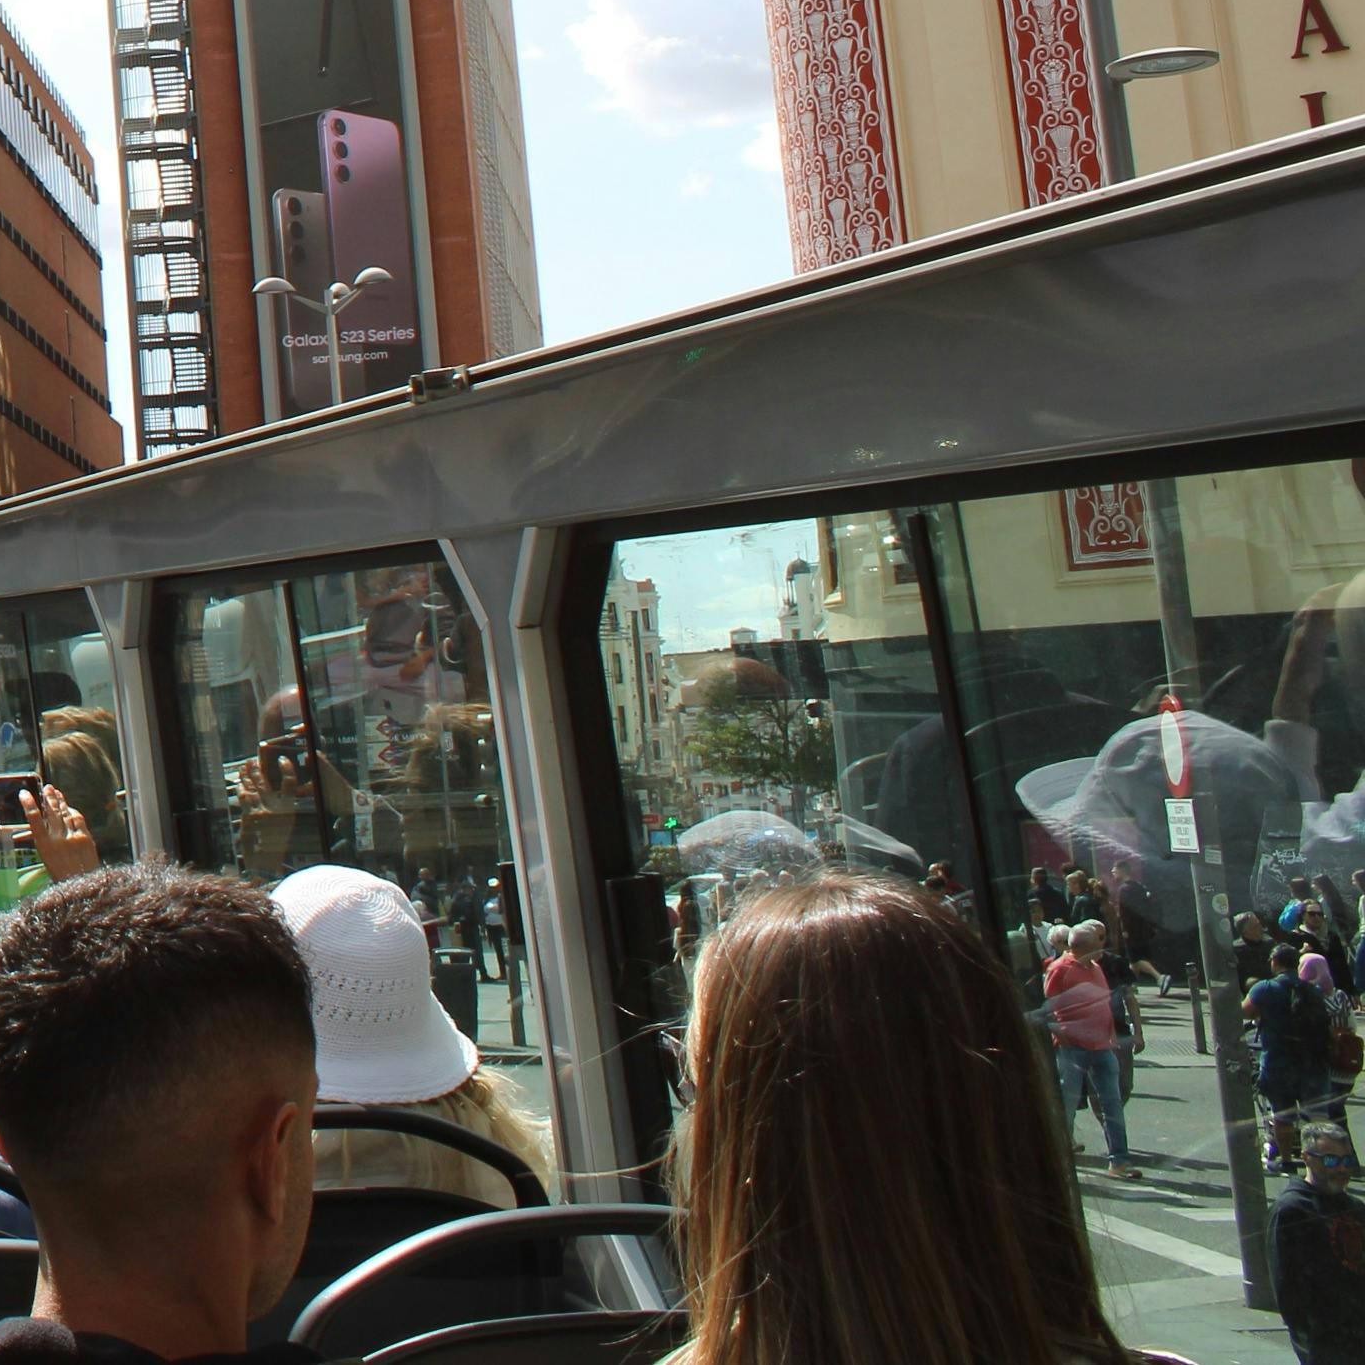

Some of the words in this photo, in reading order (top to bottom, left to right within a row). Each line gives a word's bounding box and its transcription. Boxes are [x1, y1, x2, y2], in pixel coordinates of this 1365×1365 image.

[282, 334, 330, 347] Galax
[340, 330, 366, 344] S23
[367, 327, 415, 342] Series
[312, 350, 388, 364] samung.com
